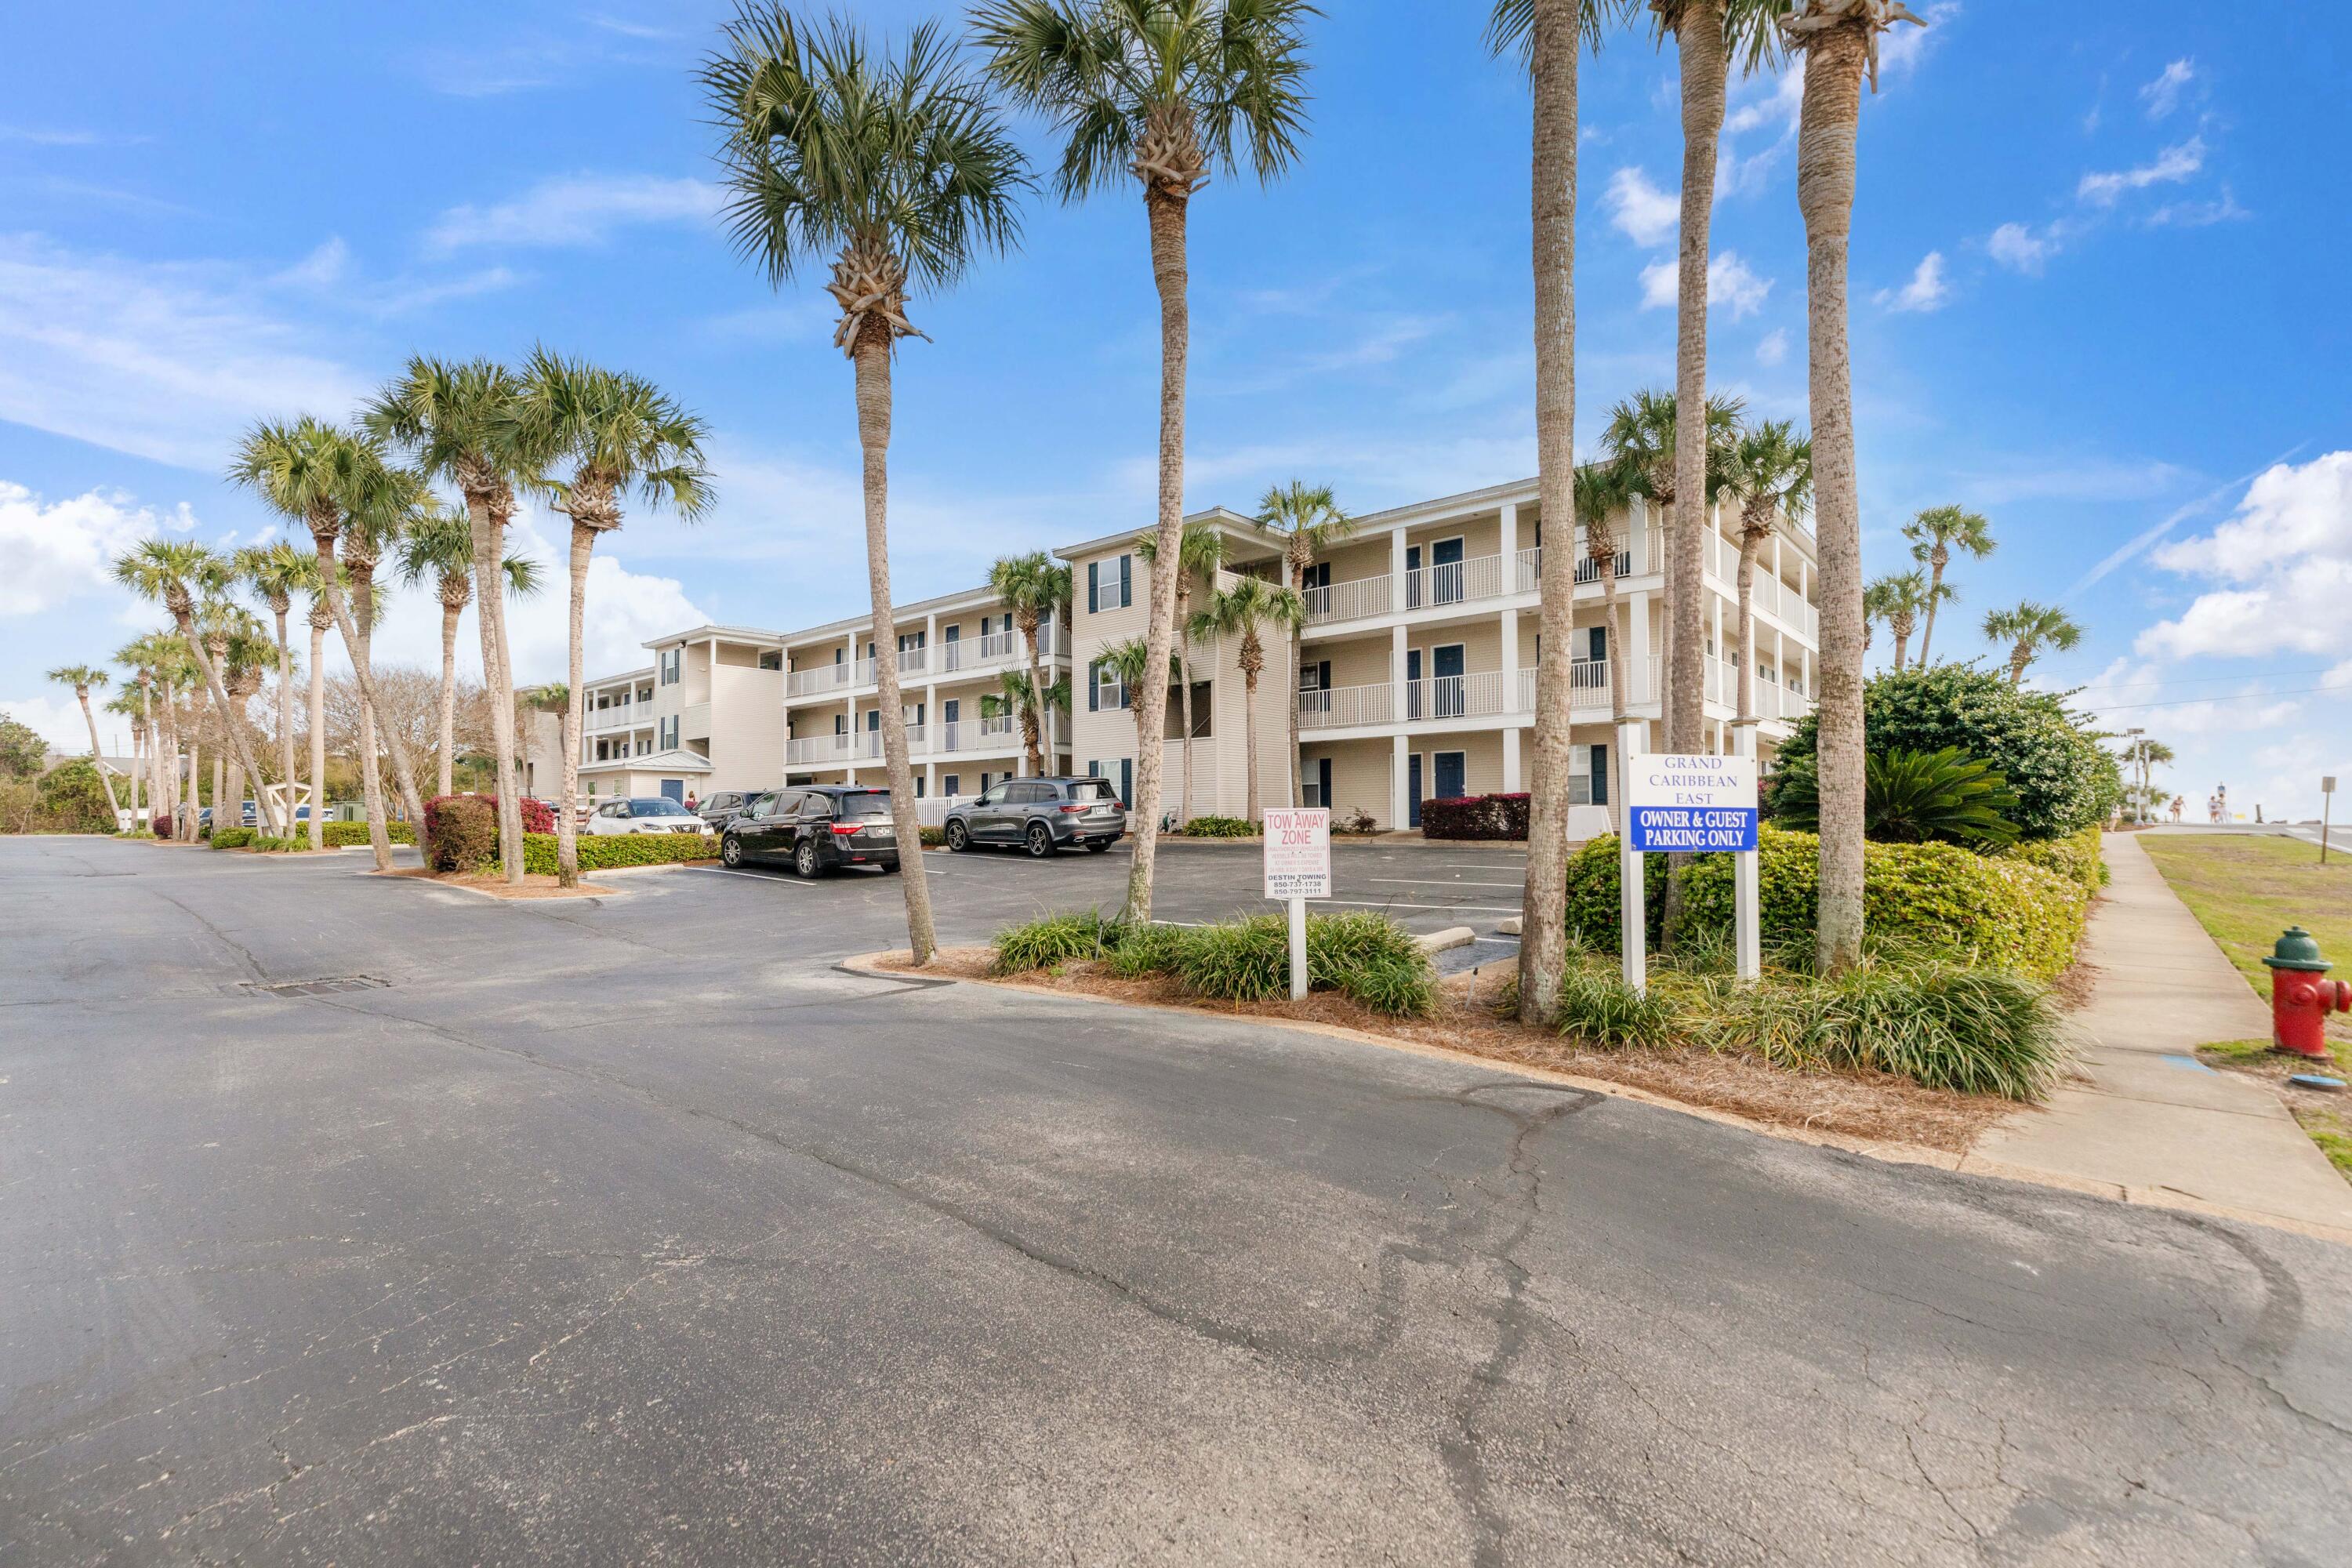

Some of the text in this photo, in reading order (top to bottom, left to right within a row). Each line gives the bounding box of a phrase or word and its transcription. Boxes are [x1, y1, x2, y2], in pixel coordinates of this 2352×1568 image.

[1664, 757, 1722, 769] GRAND
[1650, 775, 1737, 787] CARIBBEAN
[1676, 793, 1714, 804] EAST
[1267, 814, 1324, 829] TOW AWAY
[1640, 811, 1748, 828] OWNER & GUEST
[1282, 830, 1311, 844] ZONE
[1645, 829, 1744, 846] PARKING ONLY
